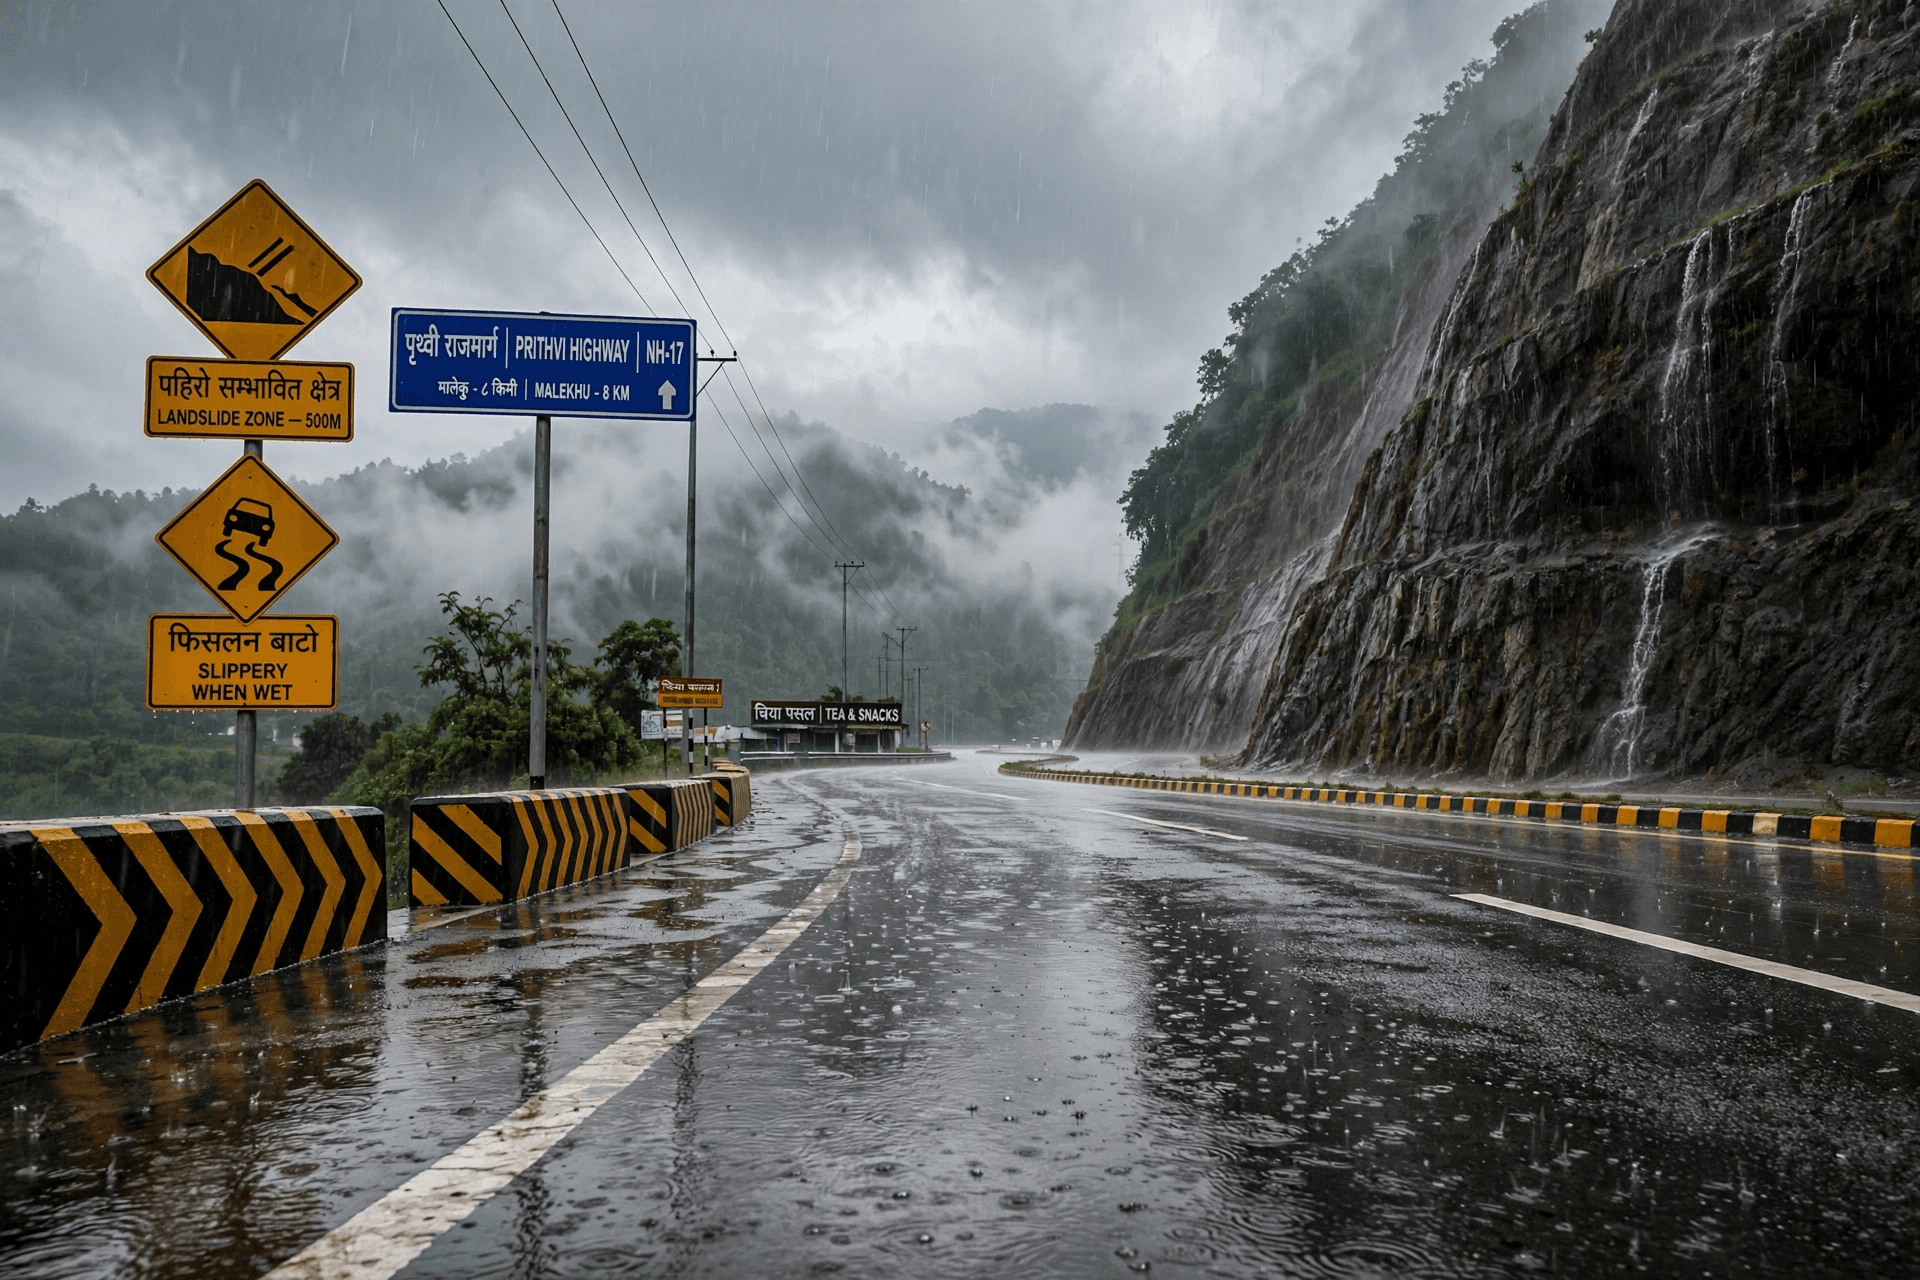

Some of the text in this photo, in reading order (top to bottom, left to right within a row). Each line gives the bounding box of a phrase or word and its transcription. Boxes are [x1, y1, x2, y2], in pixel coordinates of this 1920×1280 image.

[405, 323, 499, 365] पृथ्वी राजमार्ग
[515, 335, 630, 363] PRITHVI HIGHWAY
[646, 340, 684, 365] NH-17
[158, 367, 342, 402] पहिरो सम्भावित क्षेत्र
[437, 376, 469, 400] मालेकु
[481, 382, 489, 396] ८
[491, 378, 518, 397] किमी
[534, 382, 591, 400] MALEKHU
[602, 385, 610, 400] 8
[613, 385, 630, 401] KM
[157, 409, 240, 427] LANDSLIDE
[244, 411, 285, 427] ZONE
[305, 412, 342, 429] 500M
[168, 622, 319, 652] फिसलन बाटो
[198, 662, 288, 679] SLIPPERY
[191, 684, 293, 701] WHEN WET
[754, 702, 816, 721] चिया पसल
[825, 707, 899, 722] TEA & SNACKS
